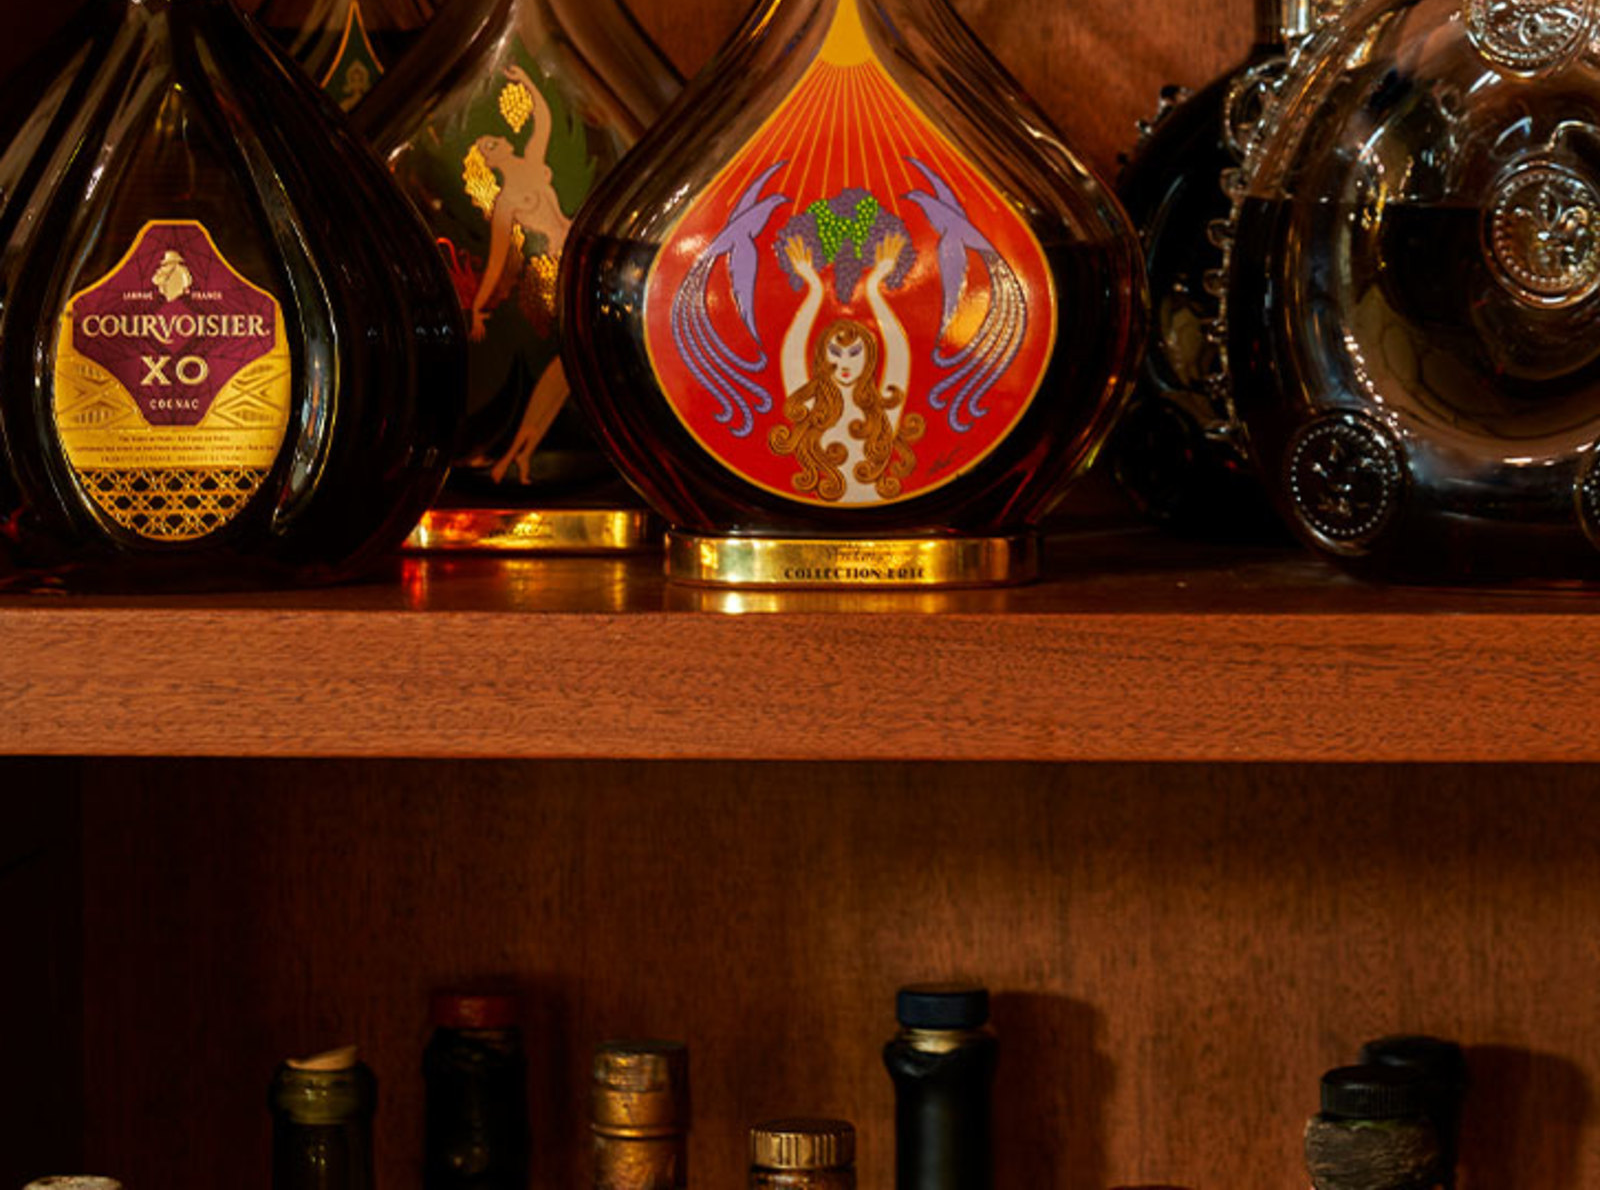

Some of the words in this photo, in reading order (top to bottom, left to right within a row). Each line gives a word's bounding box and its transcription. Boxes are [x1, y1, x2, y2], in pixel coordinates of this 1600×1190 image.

[82, 314, 267, 344] COURVOISIER
[140, 355, 208, 386] XO
[150, 398, 200, 410] COGNAC
[784, 567, 880, 579] COLLECTION
